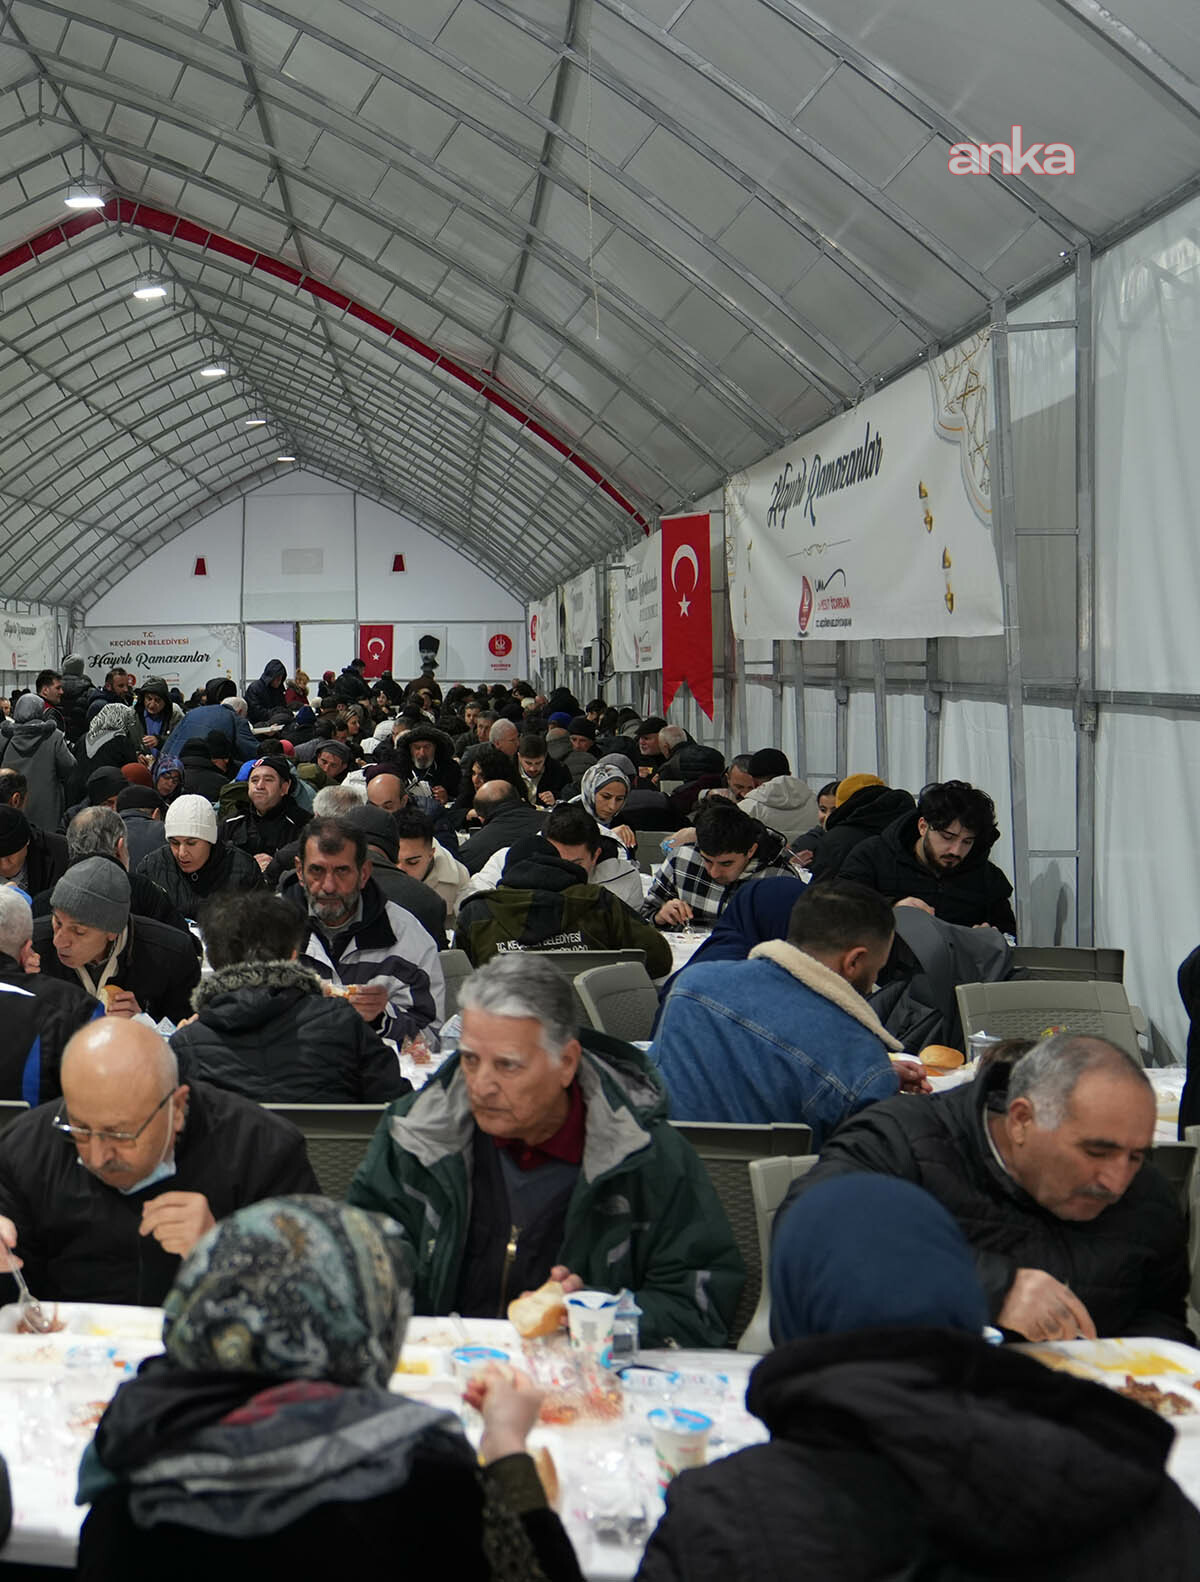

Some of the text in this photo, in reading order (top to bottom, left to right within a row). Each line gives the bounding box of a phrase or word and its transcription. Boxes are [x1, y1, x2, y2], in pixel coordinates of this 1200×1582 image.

[804, 421, 883, 528] Ramazanlar
[109, 636, 189, 648] KEÇİÖREN BELEDİYESİ
[87, 650, 211, 670] Hayırlı Ramazanlar
